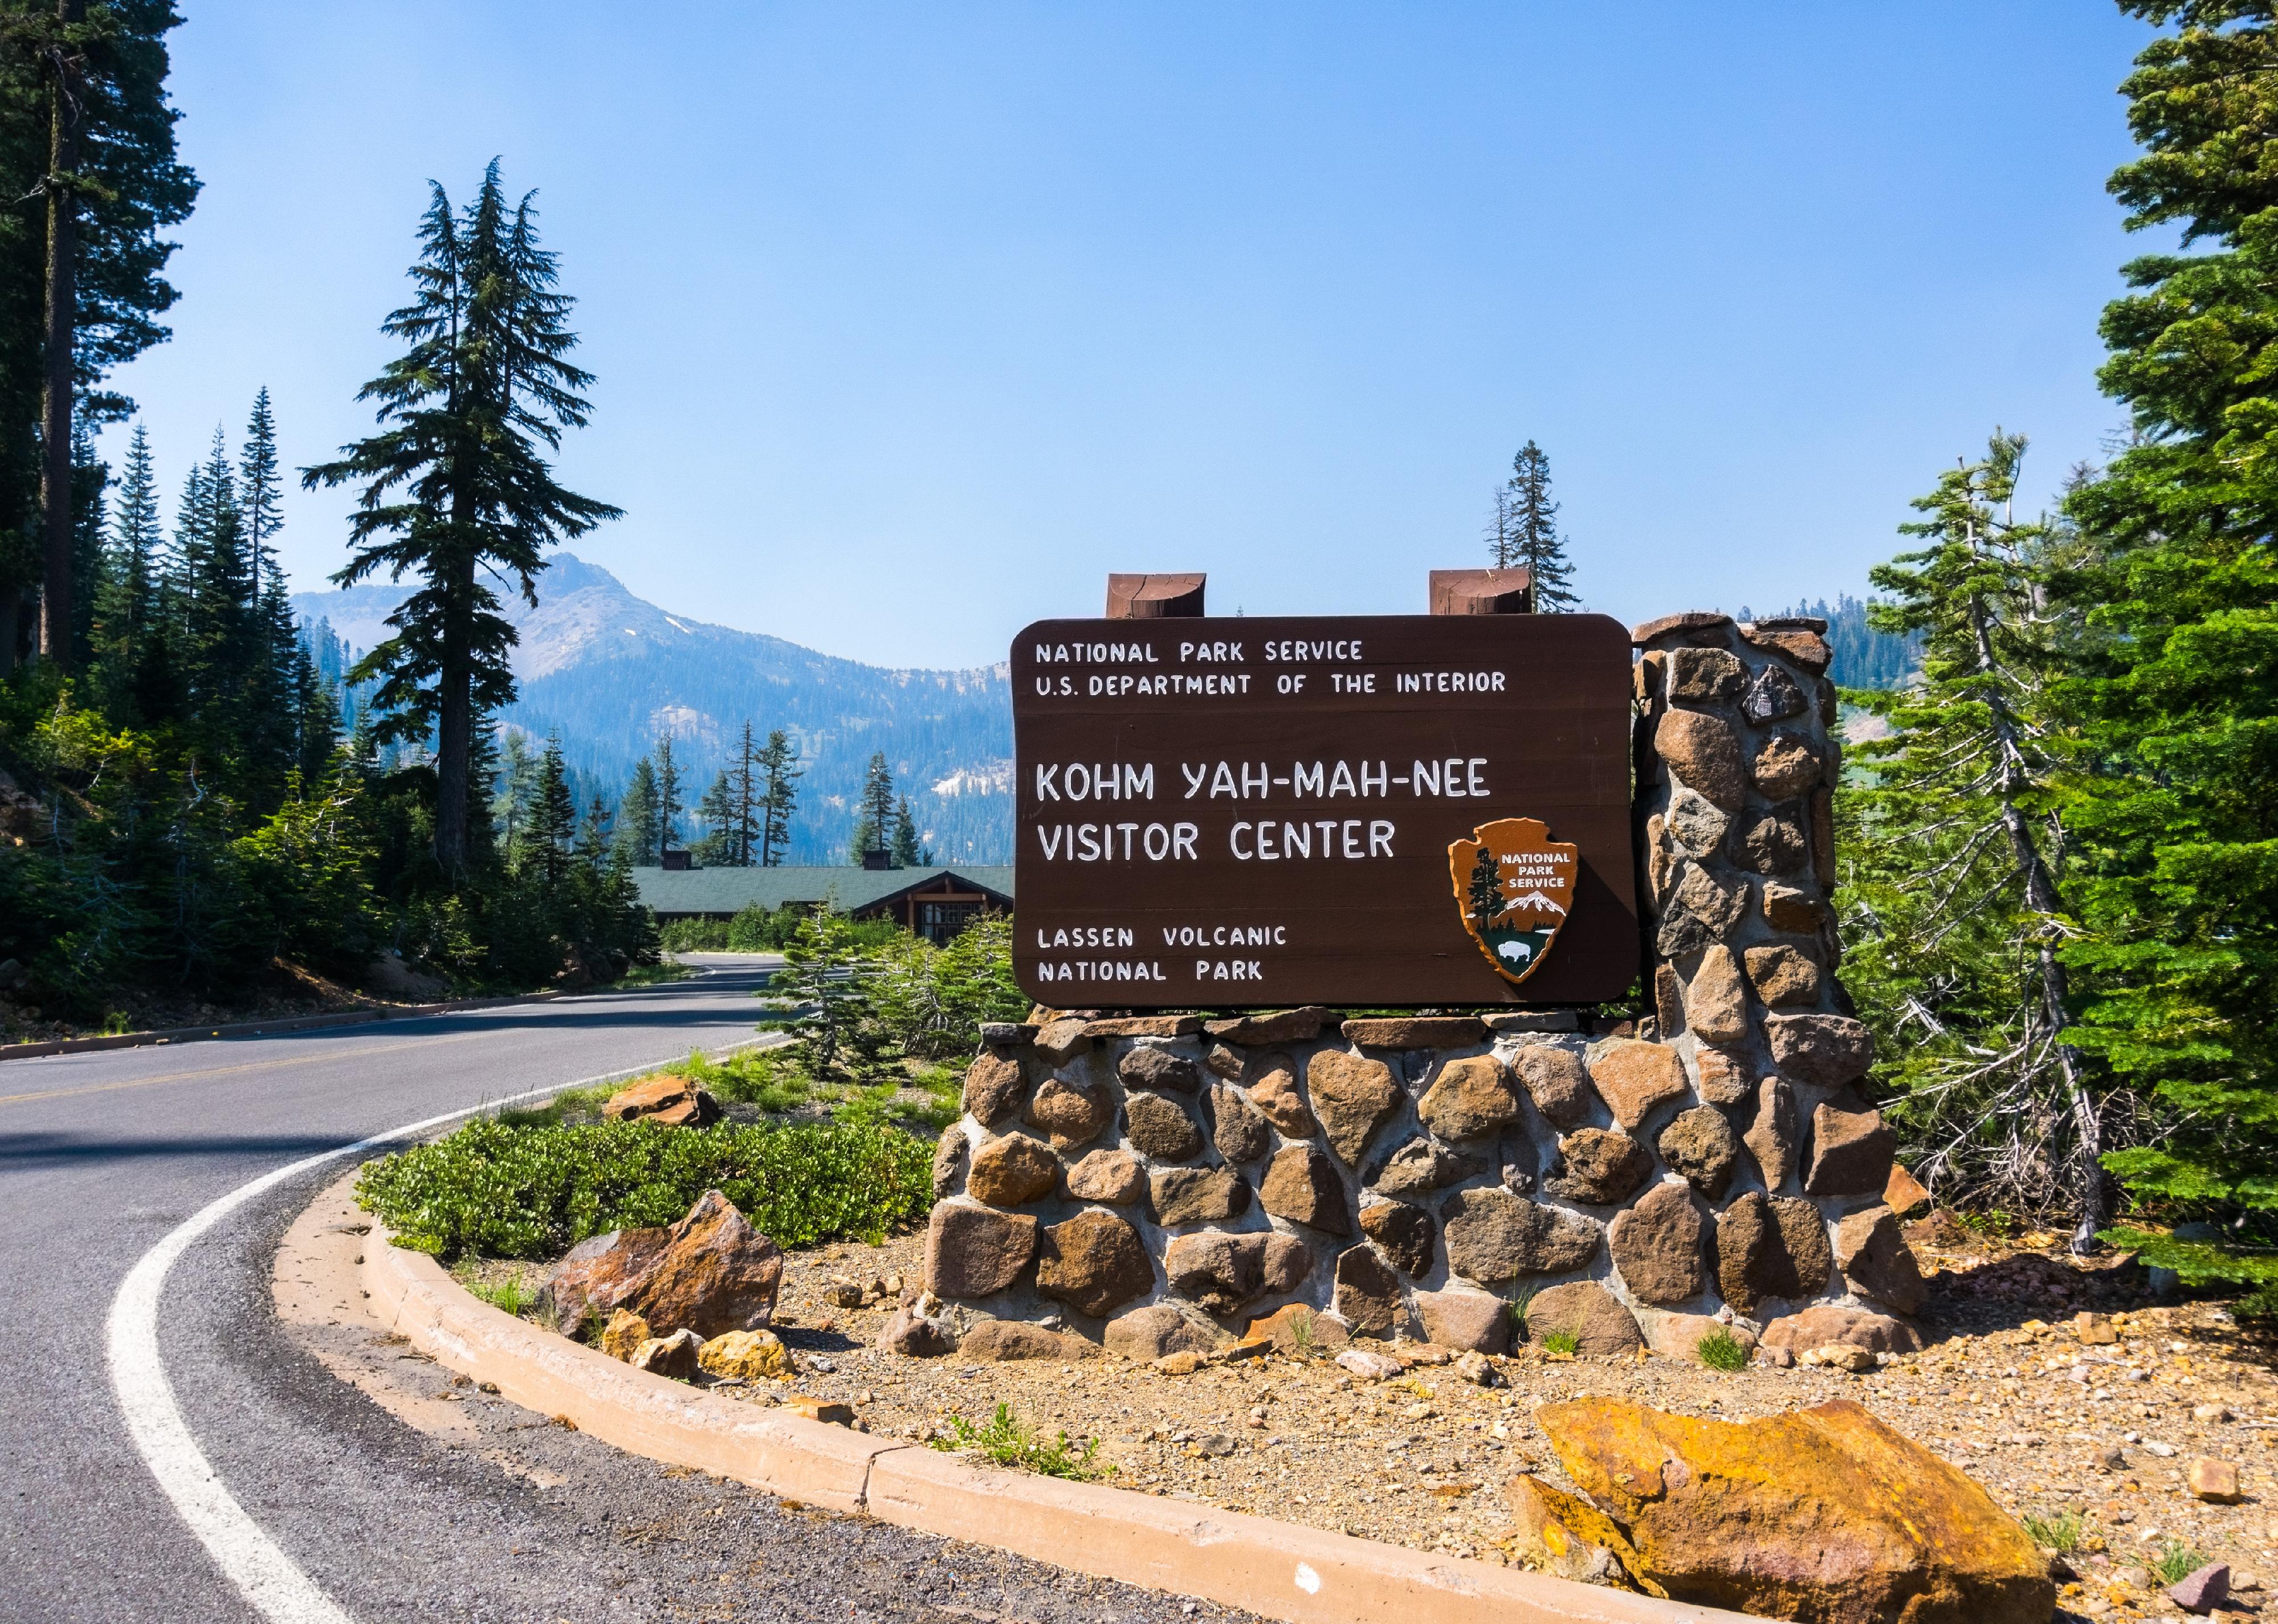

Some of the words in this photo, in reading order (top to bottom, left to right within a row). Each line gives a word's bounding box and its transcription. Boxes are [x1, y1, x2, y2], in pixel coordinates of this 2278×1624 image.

[1036, 643, 1159, 663] NATIONAL
[1180, 642, 1245, 662] PARK
[1265, 640, 1363, 661] SERVICE
[1036, 676, 1079, 696] U.S.
[1089, 675, 1251, 696] DEPARTMENT
[1277, 675, 1306, 694] OF
[1331, 674, 1376, 693] THE
[1397, 671, 1506, 692] INTERIOR
[1036, 762, 1154, 801] KOHM
[1182, 758, 1491, 799] YAH-MAH-NEE
[1037, 822, 1199, 861] VISITOR
[1230, 820, 1396, 860] CENTER
[1502, 853, 1571, 864] NATIONAL
[1518, 866, 1554, 876] PARK
[1509, 877, 1565, 888] SERVICE
[1038, 928, 1134, 948] LASSEN
[1163, 926, 1286, 946] VOLCANIC
[1038, 961, 1167, 981] NATIONAL
[1196, 960, 1263, 980] PARK
